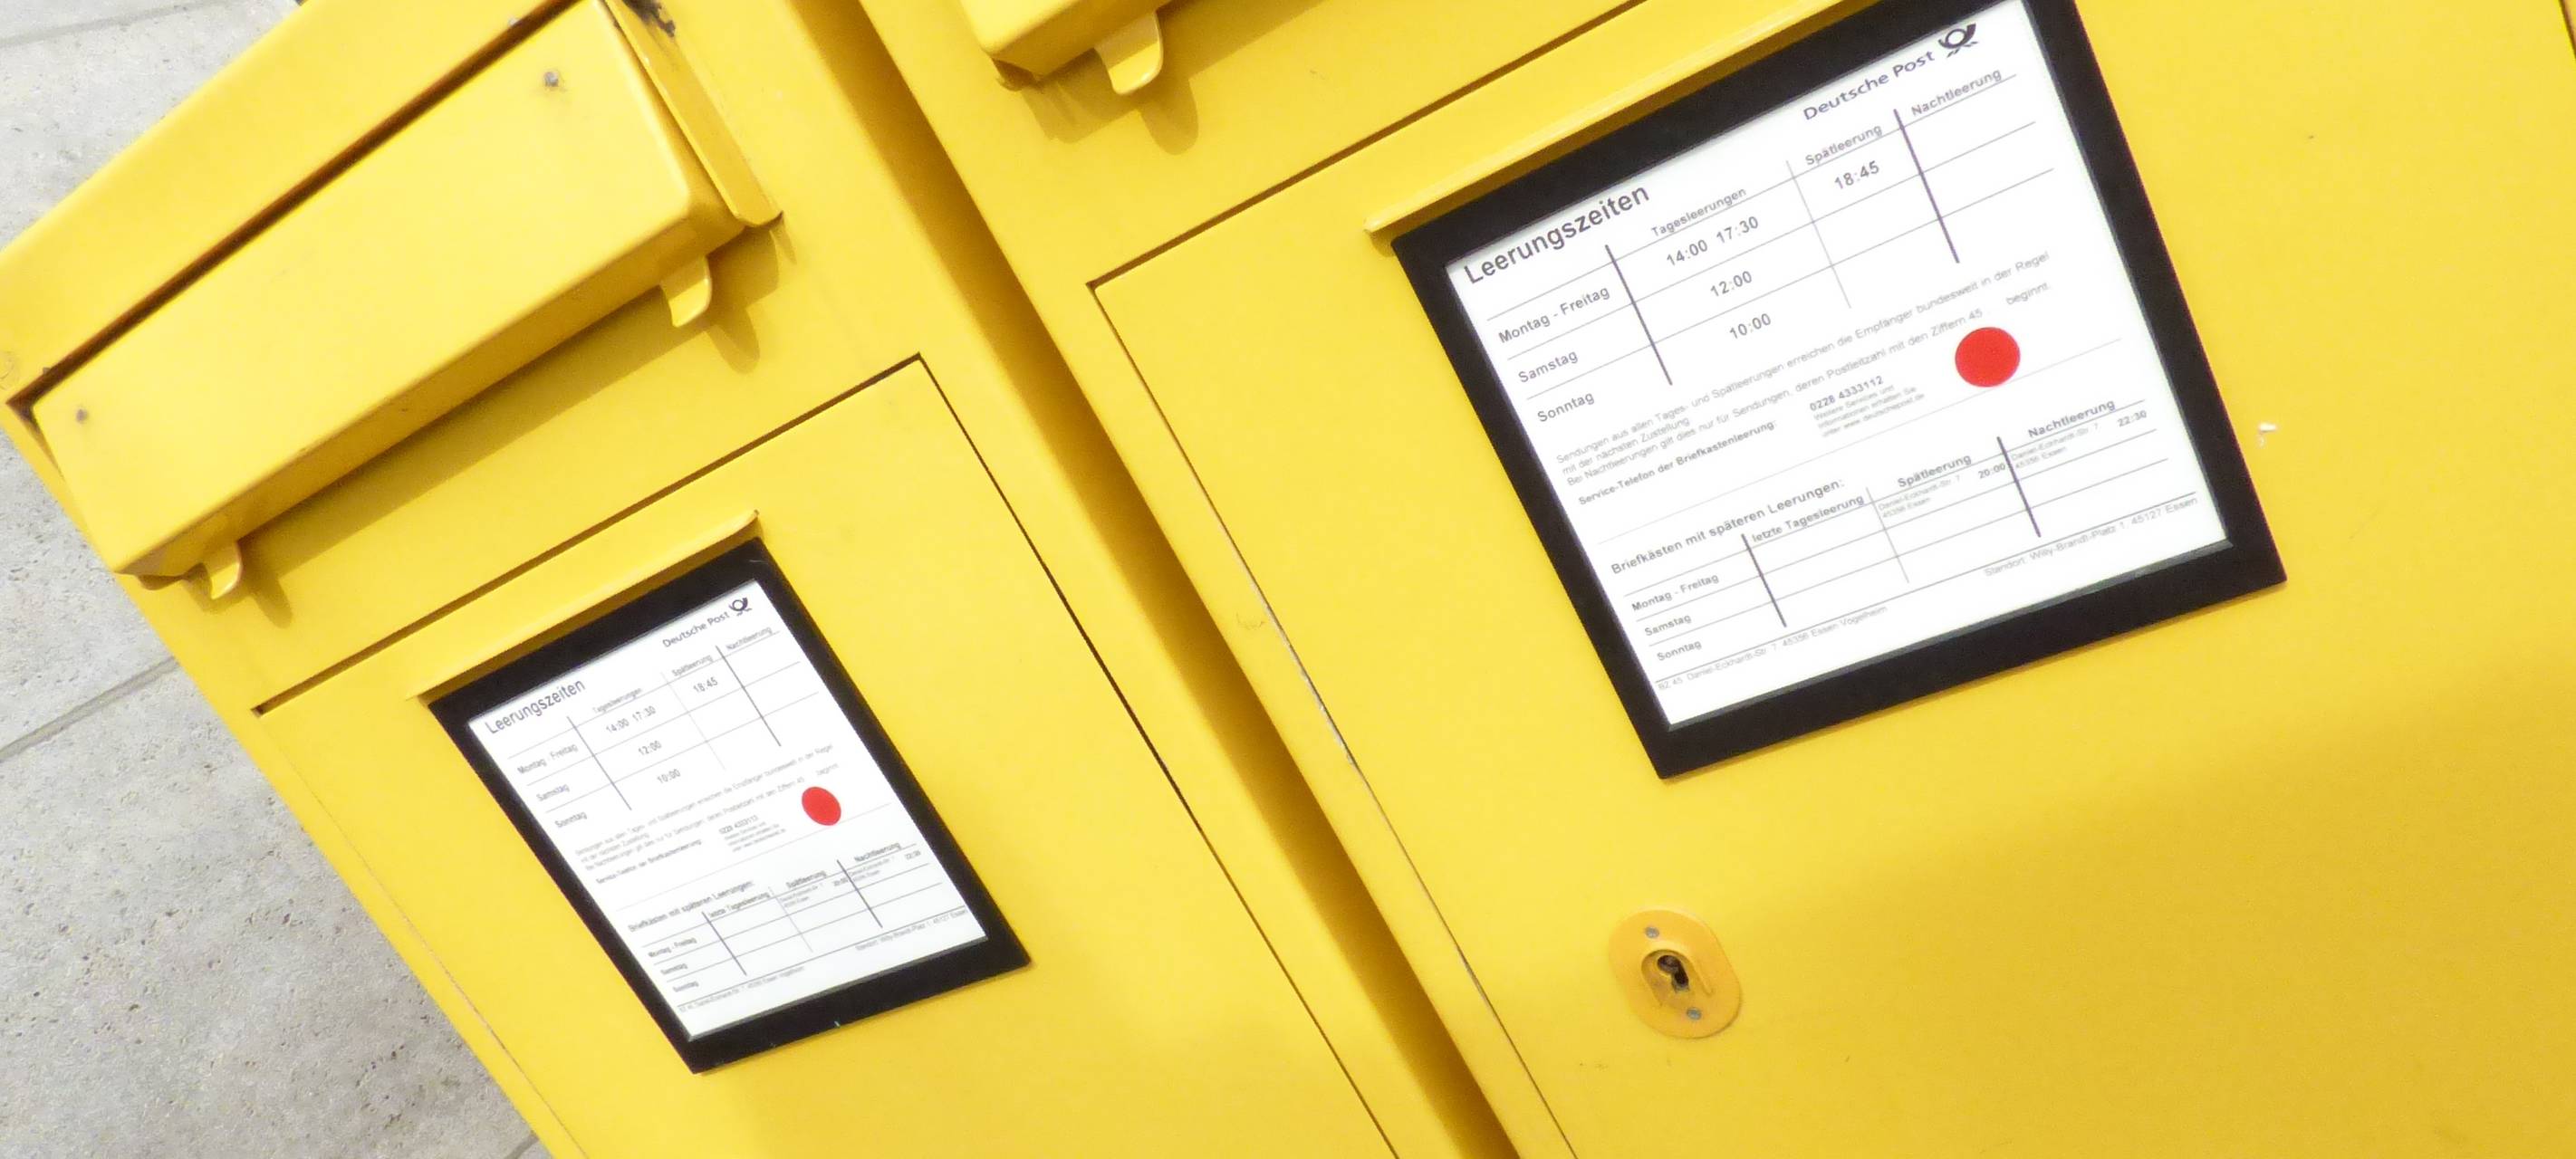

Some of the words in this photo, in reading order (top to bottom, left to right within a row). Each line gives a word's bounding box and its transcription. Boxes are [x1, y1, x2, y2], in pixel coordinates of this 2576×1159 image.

[1802, 73, 1889, 120] Deutsche
[1891, 51, 1936, 78] Post
[1910, 69, 2002, 117] Nachtleerung
[1804, 125, 1883, 166] Spätleerung
[1833, 159, 1879, 189] 18:45
[1650, 188, 1748, 236] Tagesleerungen
[1463, 187, 1649, 284] Leerungszeiten
[1666, 239, 1708, 266] 14:00
[1716, 216, 1759, 244] 17:30
[1709, 270, 1753, 297] 12:00
[1497, 314, 1551, 344] Montag
[1559, 287, 1610, 315] Freitag
[1729, 312, 1772, 339] 10:00
[1517, 350, 1579, 383] Samstag
[1611, 430, 1626, 442] aus
[1690, 393, 1711, 407] und
[1836, 334, 1853, 347] die
[1993, 267, 2012, 282] der
[1536, 392, 1595, 423] Sonntag
[1809, 394, 1836, 412] 0228
[1838, 375, 1884, 399] 4333112
[2027, 400, 2116, 438] Nachtleerung
[1577, 469, 1656, 505] Service-Telefon
[1657, 461, 1674, 474] der
[1897, 455, 1972, 488] Spätleerung
[1977, 462, 2006, 479] 20:00
[1610, 541, 1683, 574] Briefkästen
[1685, 530, 1706, 546] mit
[1708, 509, 1766, 537] späteren
[1766, 481, 1844, 514] Leerungen:
[1751, 526, 1783, 542] letzte
[1784, 495, 1865, 530] Tagesleerung
[1630, 591, 1673, 611] Montag
[1679, 574, 1720, 593] Freitag
[661, 623, 706, 648] Deutsche
[706, 610, 730, 626] Post
[1644, 615, 1692, 637] Samstag
[1656, 640, 1702, 661] Sonntag
[692, 675, 718, 693] 18:45
[484, 680, 586, 734] Leerungszeiten
[605, 717, 630, 733] 14:00
